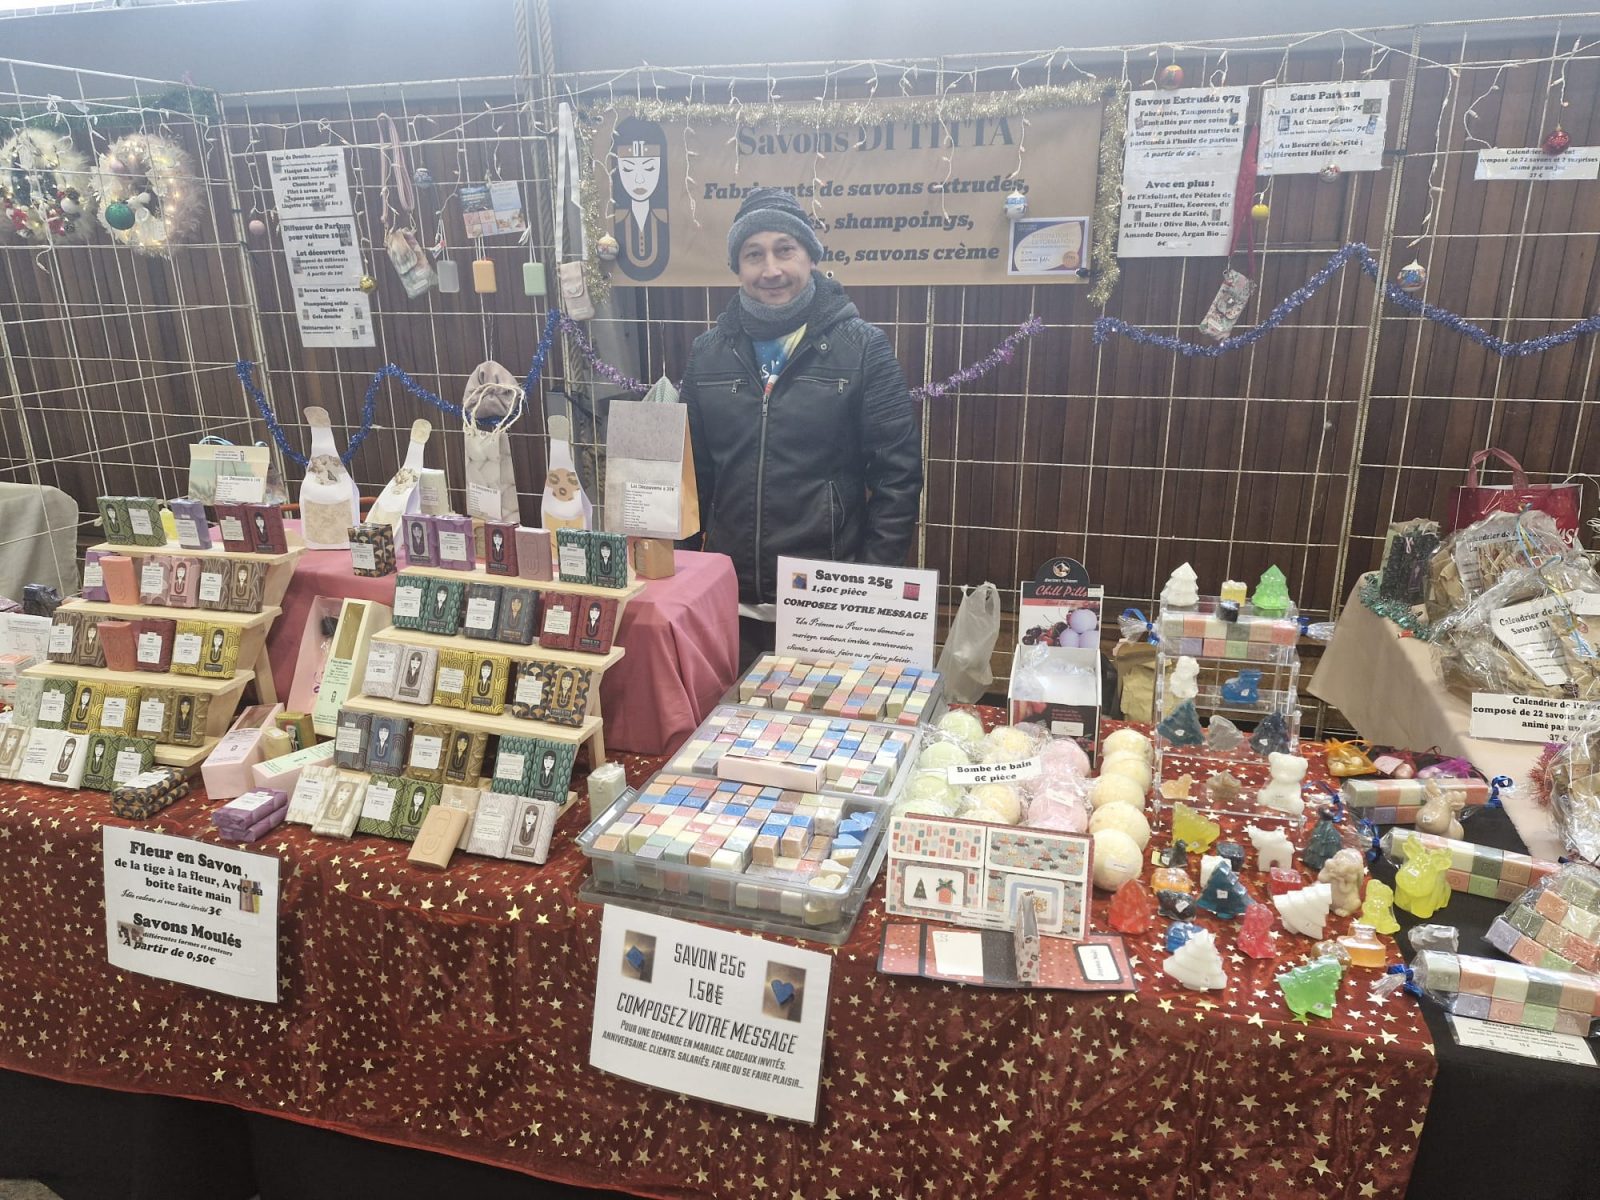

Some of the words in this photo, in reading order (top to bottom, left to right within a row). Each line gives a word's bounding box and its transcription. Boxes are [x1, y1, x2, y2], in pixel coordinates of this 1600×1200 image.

[1134, 97, 1171, 106] Savons
[1173, 96, 1220, 105] Extrudés
[1222, 95, 1241, 104] 97g
[736, 125, 849, 156] Savons
[858, 120, 896, 151] DI
[1164, 128, 1197, 136] produits
[632, 140, 645, 156] DT
[703, 182, 814, 200] Fabrnts
[820, 181, 843, 197] de
[847, 182, 922, 197] savons
[927, 175, 1030, 195] extrudés,
[1146, 181, 1171, 189] Avec
[1187, 180, 1210, 189] plus
[834, 211, 974, 232] shampoings,
[854, 248, 929, 262] savons
[933, 241, 1000, 261] crème
[815, 569, 864, 584] Savons
[868, 575, 894, 589] 25g
[841, 587, 868, 597] pièce
[1036, 585, 1063, 596] Chill
[1063, 586, 1088, 598] Pills
[784, 598, 837, 610] COMPOSEZ
[840, 604, 875, 614] VOTRE
[877, 608, 928, 620] MESSAGE
[1500, 612, 1539, 626] Calendrier
[1542, 608, 1552, 616] de
[795, 617, 807, 625] Un
[809, 617, 834, 628] Prénom
[845, 621, 863, 631] Pour
[877, 627, 905, 636] demande
[1511, 625, 1538, 634] Savons
[792, 633, 818, 641] mariage,
[820, 635, 846, 643] cadeaux
[872, 641, 914, 651] anniversaire,
[836, 649, 853, 657] faire
[868, 652, 887, 662] faire
[1513, 697, 1557, 708] Calendrier
[1473, 706, 1517, 715] composé
[1520, 708, 1530, 716] de
[1546, 712, 1575, 720] savons
[1522, 720, 1549, 729] animé
[1551, 724, 1565, 732] par
[957, 765, 992, 774] Bombe
[1009, 760, 1032, 770] bain
[990, 773, 1017, 783] pièce
[130, 840, 173, 860] Fleur
[177, 850, 194, 865] en
[197, 853, 242, 876] Savon
[114, 858, 126, 867] de
[130, 859, 140, 871] la
[144, 863, 165, 876] tige
[168, 866, 174, 875] à
[178, 867, 188, 879] la
[190, 870, 220, 888] fleur,
[222, 878, 248, 893] Avec
[145, 878, 175, 891] boite
[177, 882, 203, 897] faite
[205, 891, 232, 905] main
[121, 889, 135, 898] Idée
[135, 894, 156, 903] cadeau
[191, 904, 208, 912] invité
[208, 906, 222, 916] 3€
[133, 913, 188, 935] Savons
[191, 923, 242, 949] Moulés
[123, 937, 131, 947] A
[134, 939, 169, 955] partir
[170, 947, 184, 958] de
[186, 951, 217, 965] 0,50€
[142, 932, 177, 943] différentes
[178, 938, 200, 948] formes
[208, 946, 233, 956] senteurs
[674, 943, 719, 972] SAVON
[720, 953, 746, 978] 25G
[616, 992, 687, 1029] COMPOSEZ
[688, 1012, 730, 1039] VOTRE
[730, 1021, 799, 1055] MESSAGE
[637, 1026, 651, 1037] UNE
[651, 1030, 683, 1046] DEMANDE
[683, 1038, 693, 1048] EN
[726, 1049, 758, 1064] CADEAUX
[711, 1060, 732, 1073] FAIRE
[732, 1065, 741, 1075] OU
[742, 1067, 752, 1077] SE
[752, 1070, 772, 1082] FAIRE
